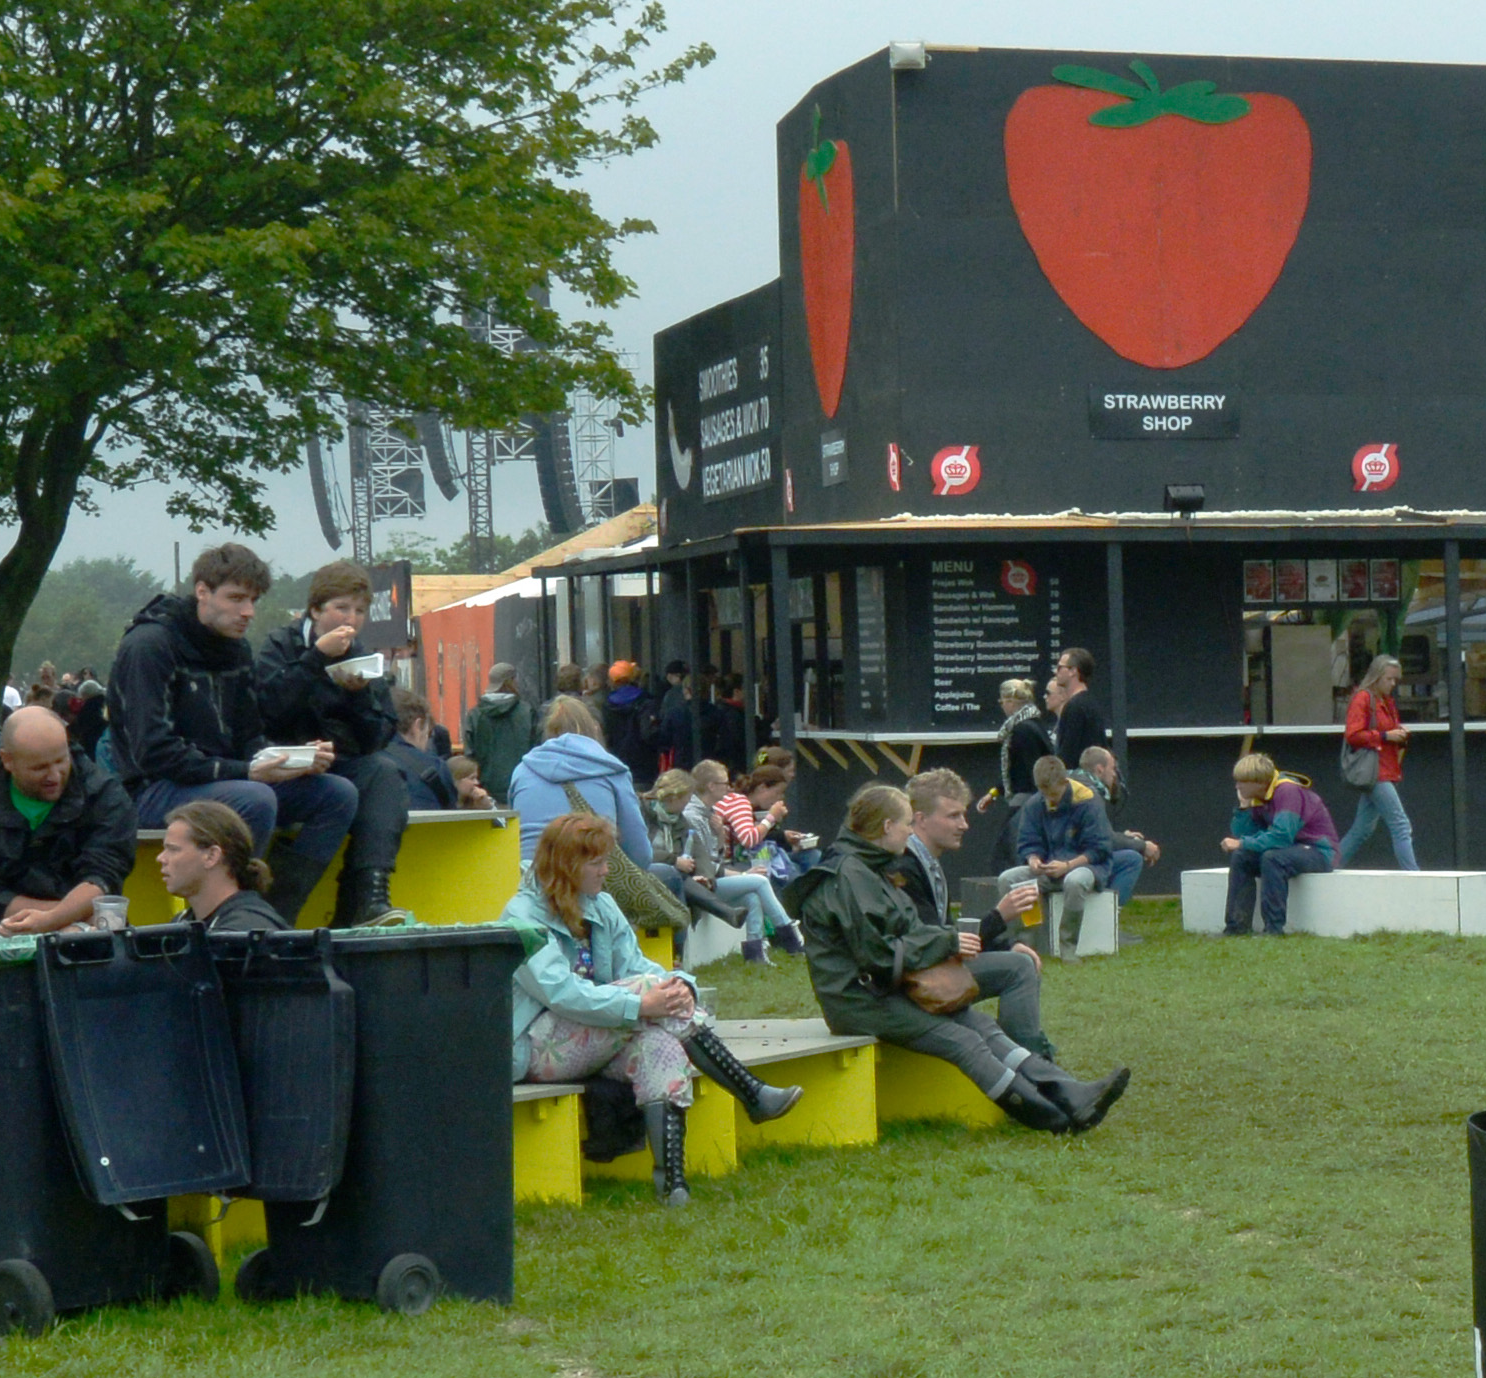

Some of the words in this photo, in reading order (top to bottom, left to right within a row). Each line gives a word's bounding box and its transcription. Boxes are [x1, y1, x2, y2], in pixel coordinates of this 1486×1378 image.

[1103, 394, 1226, 410] STRAWBERRY
[1143, 416, 1193, 431] SHOP
[932, 561, 974, 573] MENU
